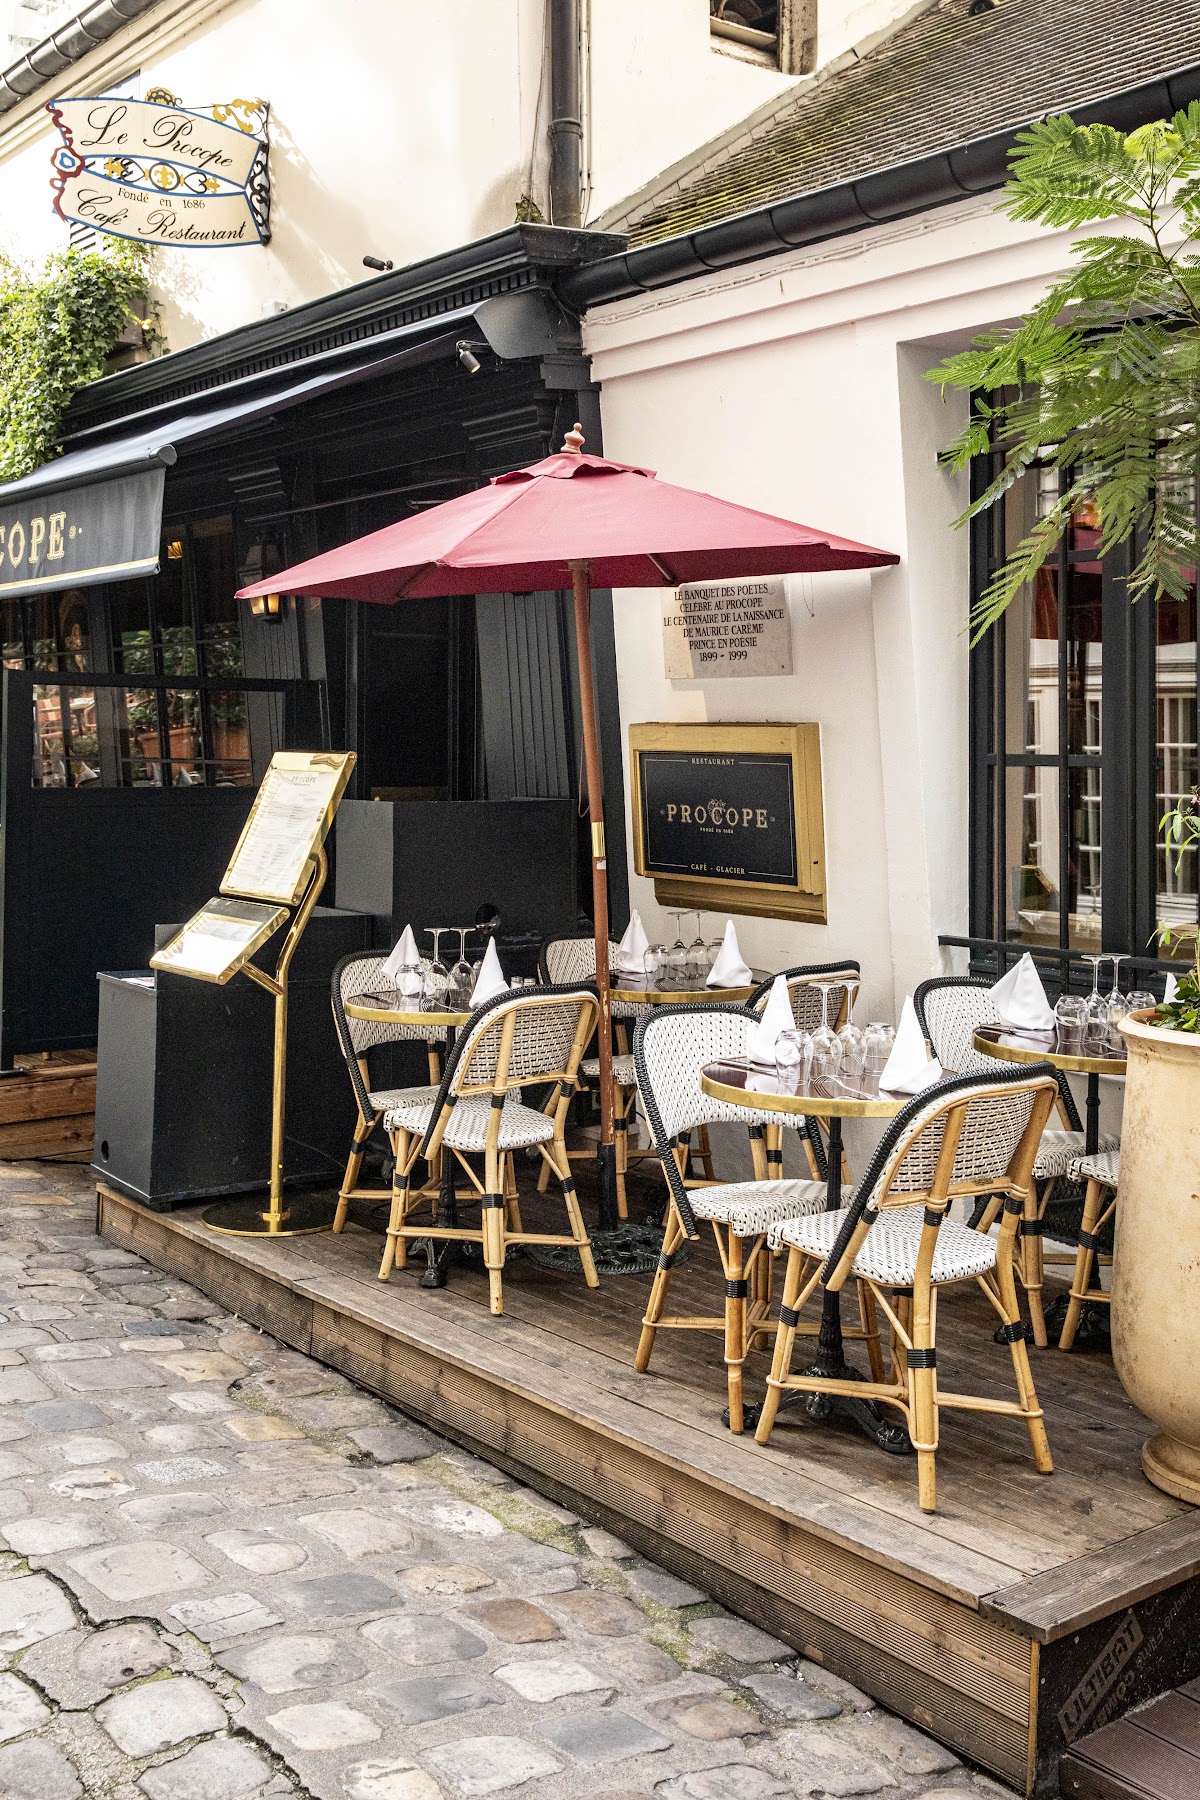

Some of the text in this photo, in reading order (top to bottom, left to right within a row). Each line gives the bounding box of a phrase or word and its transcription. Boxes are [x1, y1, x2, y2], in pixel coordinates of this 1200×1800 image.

[80, 105, 234, 168] Le Procope
[117, 187, 206, 209] Fondé en 1686
[77, 188, 246, 240] Café Restaurant
[674, 591, 683, 600] LE
[684, 588, 720, 600] BANQUET
[721, 587, 736, 597] DES
[714, 600, 724, 610] AU
[726, 598, 763, 610] PROCOPE
[663, 609, 784, 626] LE CENTENAIRE DE LA NAISSANCE
[683, 623, 764, 638] DE MAURICE CARÊME
[689, 635, 758, 650] PRINCE EN POÉSIE
[699, 652, 718, 662] 1899
[728, 650, 748, 661] 1999
[691, 757, 735, 766] RESTAURANT
[667, 804, 768, 828] PROCOPE
[690, 863, 708, 871] CAFÉ
[716, 865, 745, 875] GLACIER
